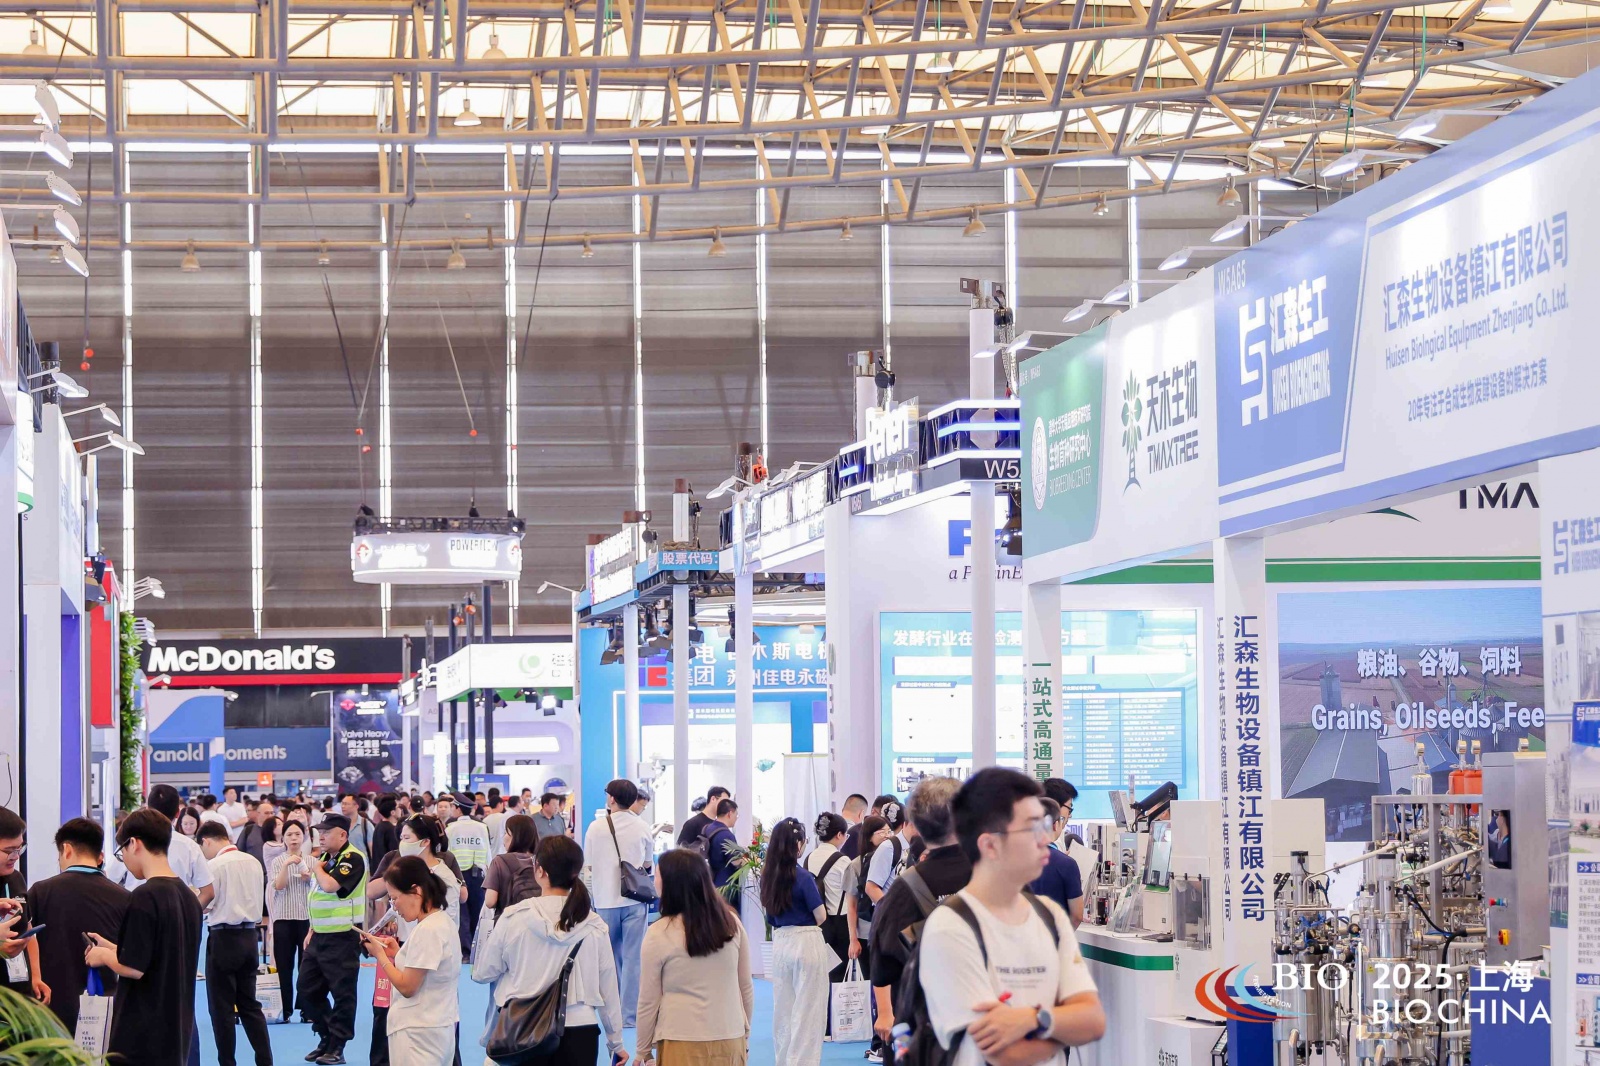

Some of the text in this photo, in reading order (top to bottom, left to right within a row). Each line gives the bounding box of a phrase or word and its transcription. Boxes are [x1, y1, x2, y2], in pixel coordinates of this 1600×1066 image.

[1218, 259, 1246, 296] W5A65
[1383, 211, 1569, 332] 汇森生物设备镇江有限公司
[1270, 275, 1329, 356] 汇森生工
[1385, 344, 1409, 370] Huisen
[1492, 301, 1534, 334] Zhenjiang
[1146, 359, 1198, 437] 天木生物
[1407, 357, 1548, 422] 20年专注于合成生物发酵设备的解决方案
[983, 459, 1021, 479] W5
[1147, 429, 1198, 474] TMAXTREE
[949, 569, 959, 580] a
[147, 645, 336, 672] McDonald's
[1357, 646, 1522, 677] 粮油、谷物、饲料
[341, 730, 390, 739] Valve Heavy
[1031, 661, 1053, 782] 一站式高通量
[1311, 704, 1388, 735] Grains,
[1395, 702, 1496, 733] Oilseeds,
[149, 743, 287, 763] anold oments
[1233, 615, 1266, 922] 汇森生物设备镇江有限公司
[456, 837, 481, 845] SNIEC
